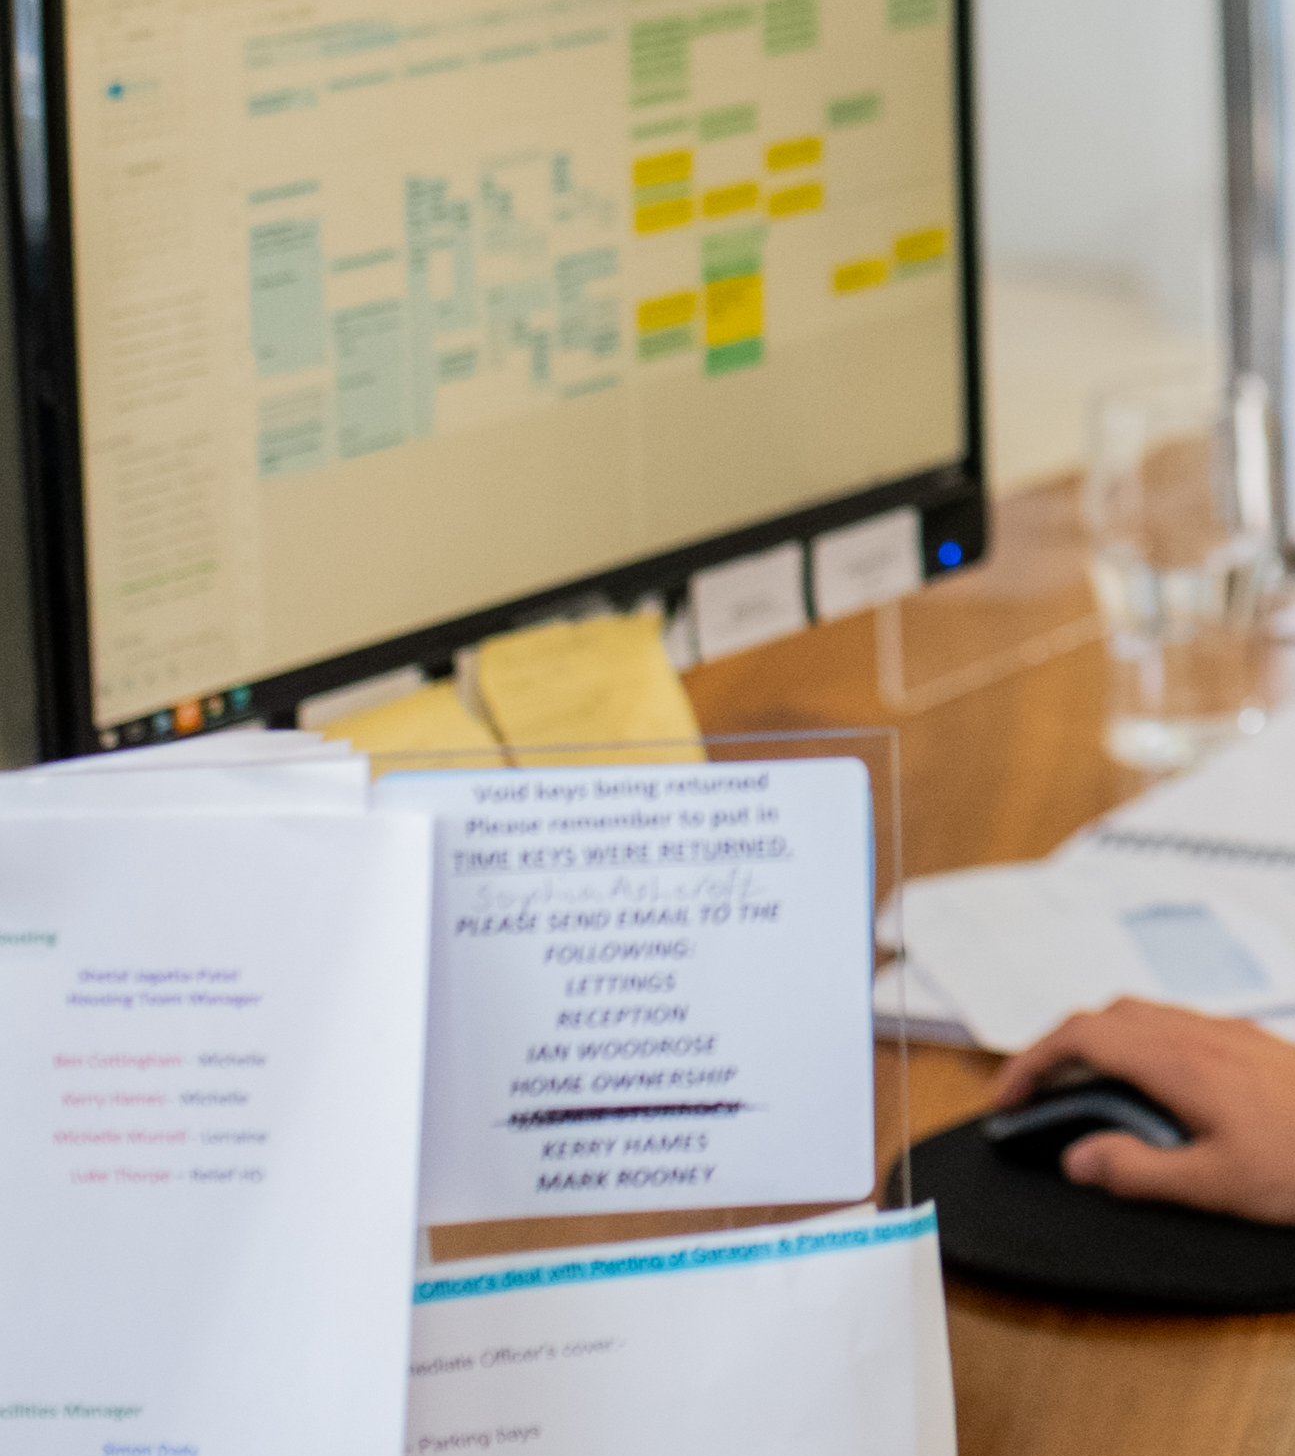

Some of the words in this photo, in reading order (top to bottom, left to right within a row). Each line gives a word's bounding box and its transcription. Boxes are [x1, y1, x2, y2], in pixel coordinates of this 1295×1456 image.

[473, 782, 529, 803] Void
[534, 781, 588, 803] keys
[593, 777, 659, 801] being
[665, 772, 770, 794] returned
[464, 817, 543, 837] Please
[547, 810, 672, 831] remember
[678, 809, 705, 827] to
[710, 806, 750, 829] put
[756, 806, 779, 823] in
[453, 849, 509, 872] TIME
[518, 845, 577, 869] KEYS
[585, 842, 649, 866] WERE
[657, 835, 794, 861] RETURNED.
[454, 912, 539, 936] PLEASE
[546, 907, 611, 931] SEND
[617, 905, 690, 929] EMAIL
[699, 902, 731, 926] TO
[738, 900, 784, 923] THE
[565, 972, 677, 997] LETTINGS
[555, 1004, 690, 1029] RECEPTION
[526, 1042, 571, 1064] IAN
[509, 1076, 583, 1097] HOME
[591, 1065, 739, 1093] OWNERSHIP
[541, 1137, 619, 1161] KERRY
[534, 1170, 610, 1194] MARK
[615, 1163, 718, 1189] ROONEY
[691, 1242, 772, 1265] Garages
[410, 1354, 474, 1376] ediate
[0, 1403, 58, 1418] cilities
[63, 1404, 143, 1421] Manager
[417, 1433, 490, 1455] Parking
